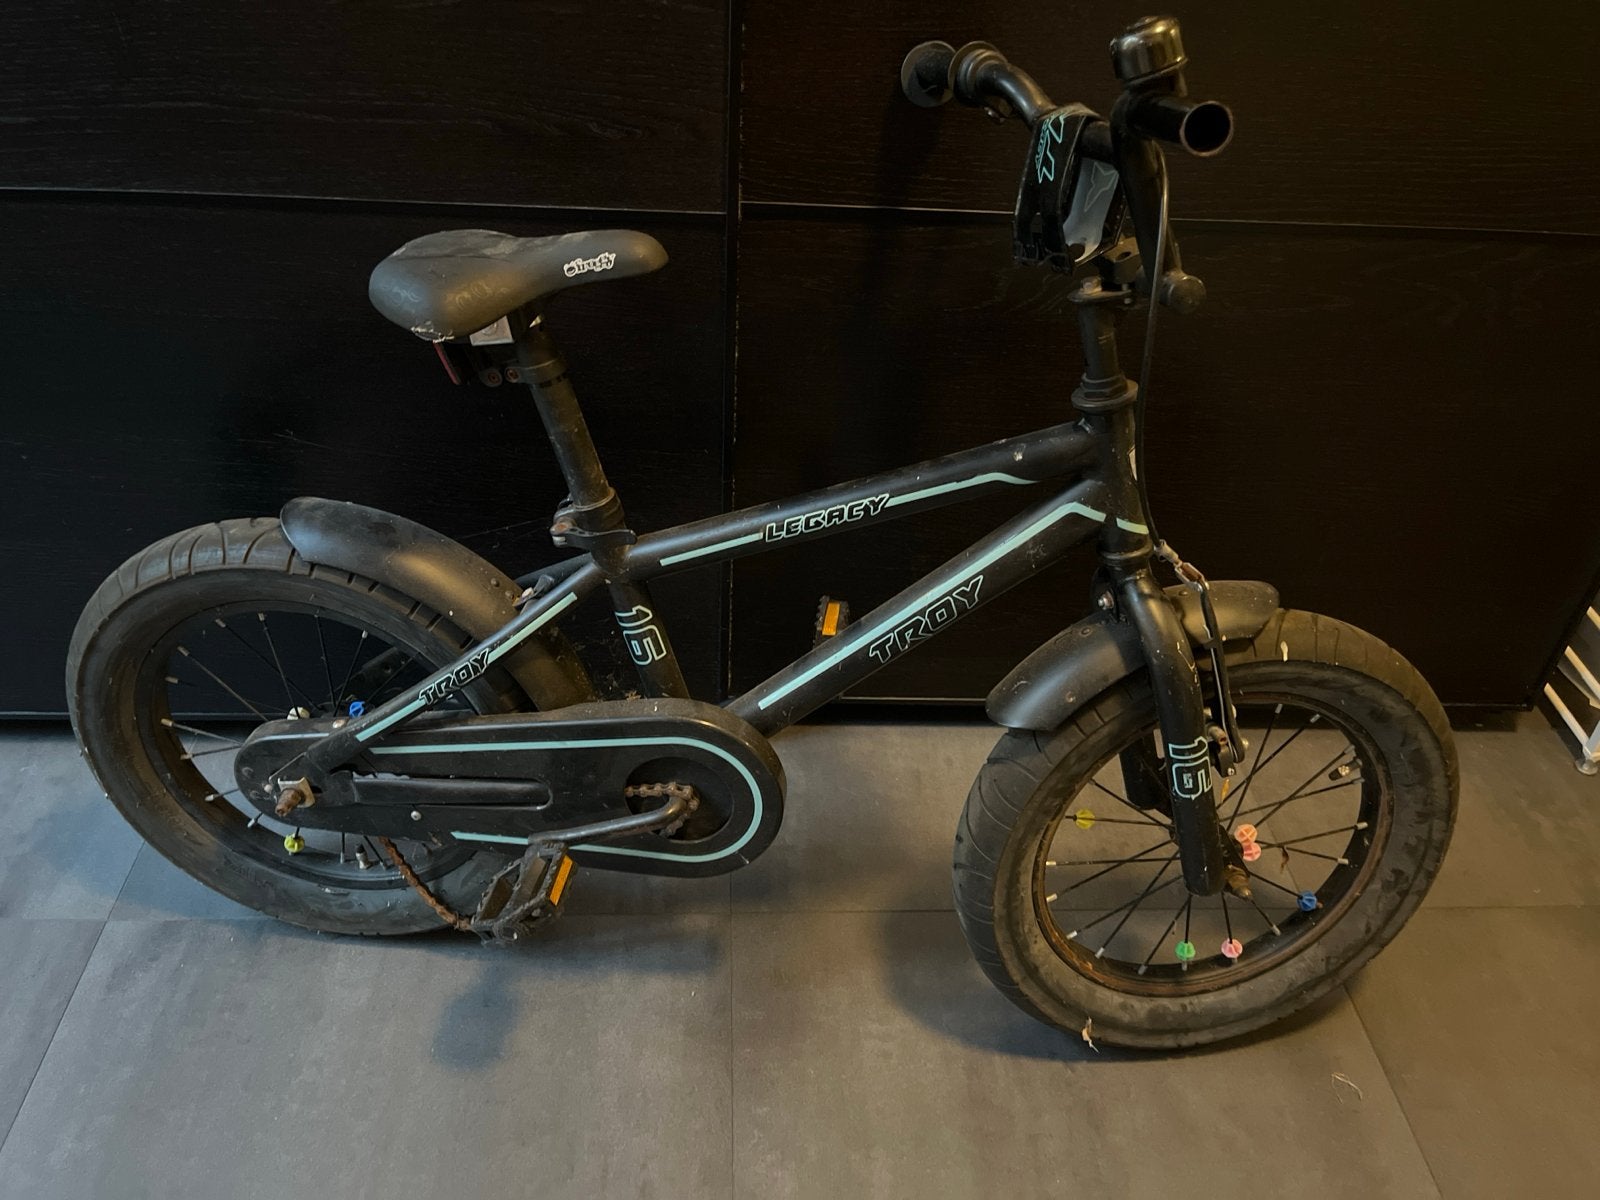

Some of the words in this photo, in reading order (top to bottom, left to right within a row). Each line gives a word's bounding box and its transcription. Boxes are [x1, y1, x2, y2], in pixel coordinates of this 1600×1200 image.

[765, 493, 889, 542] LEGACY
[614, 604, 667, 666] 16
[869, 574, 984, 664] TROY
[418, 647, 489, 705] TROY
[1168, 736, 1213, 800] 16
